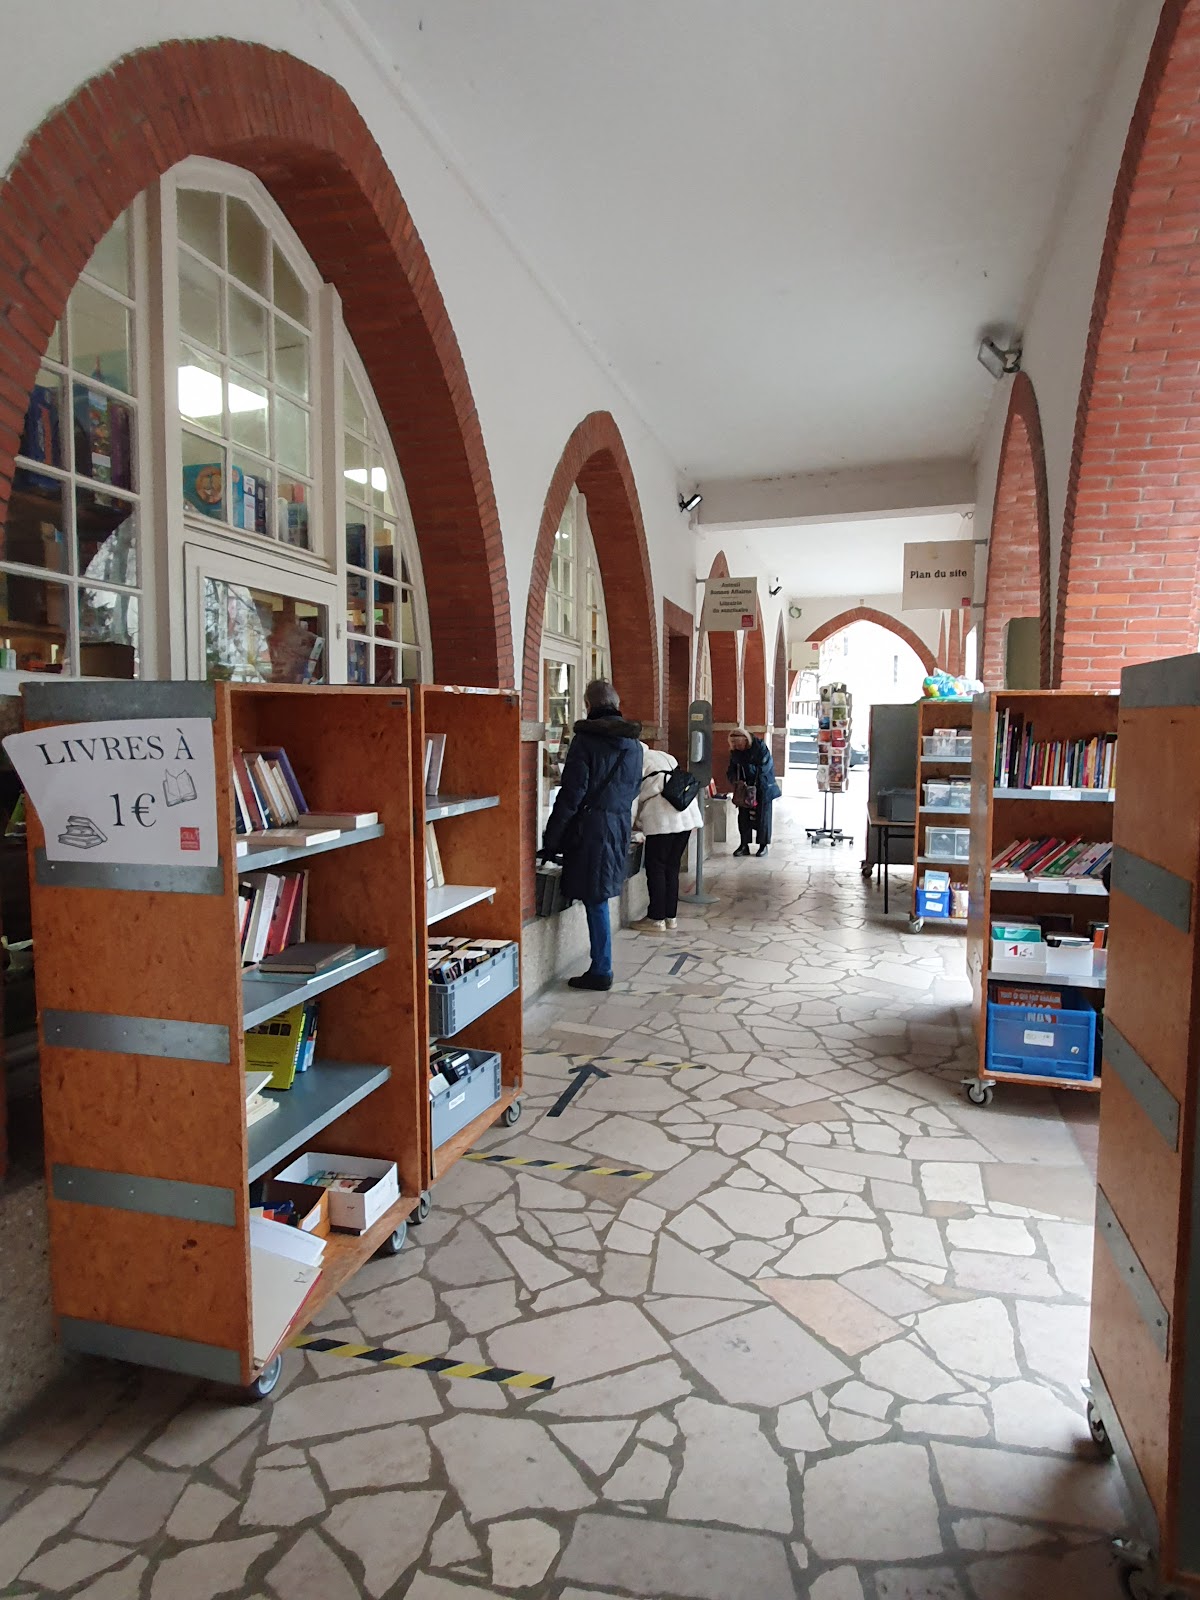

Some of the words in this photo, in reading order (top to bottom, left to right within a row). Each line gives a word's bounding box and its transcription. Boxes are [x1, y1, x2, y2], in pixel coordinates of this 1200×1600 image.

[910, 570, 931, 579] Plan
[934, 569, 946, 578] du
[949, 569, 968, 577] site
[35, 735, 165, 766] LIVRES
[174, 728, 194, 760] À
